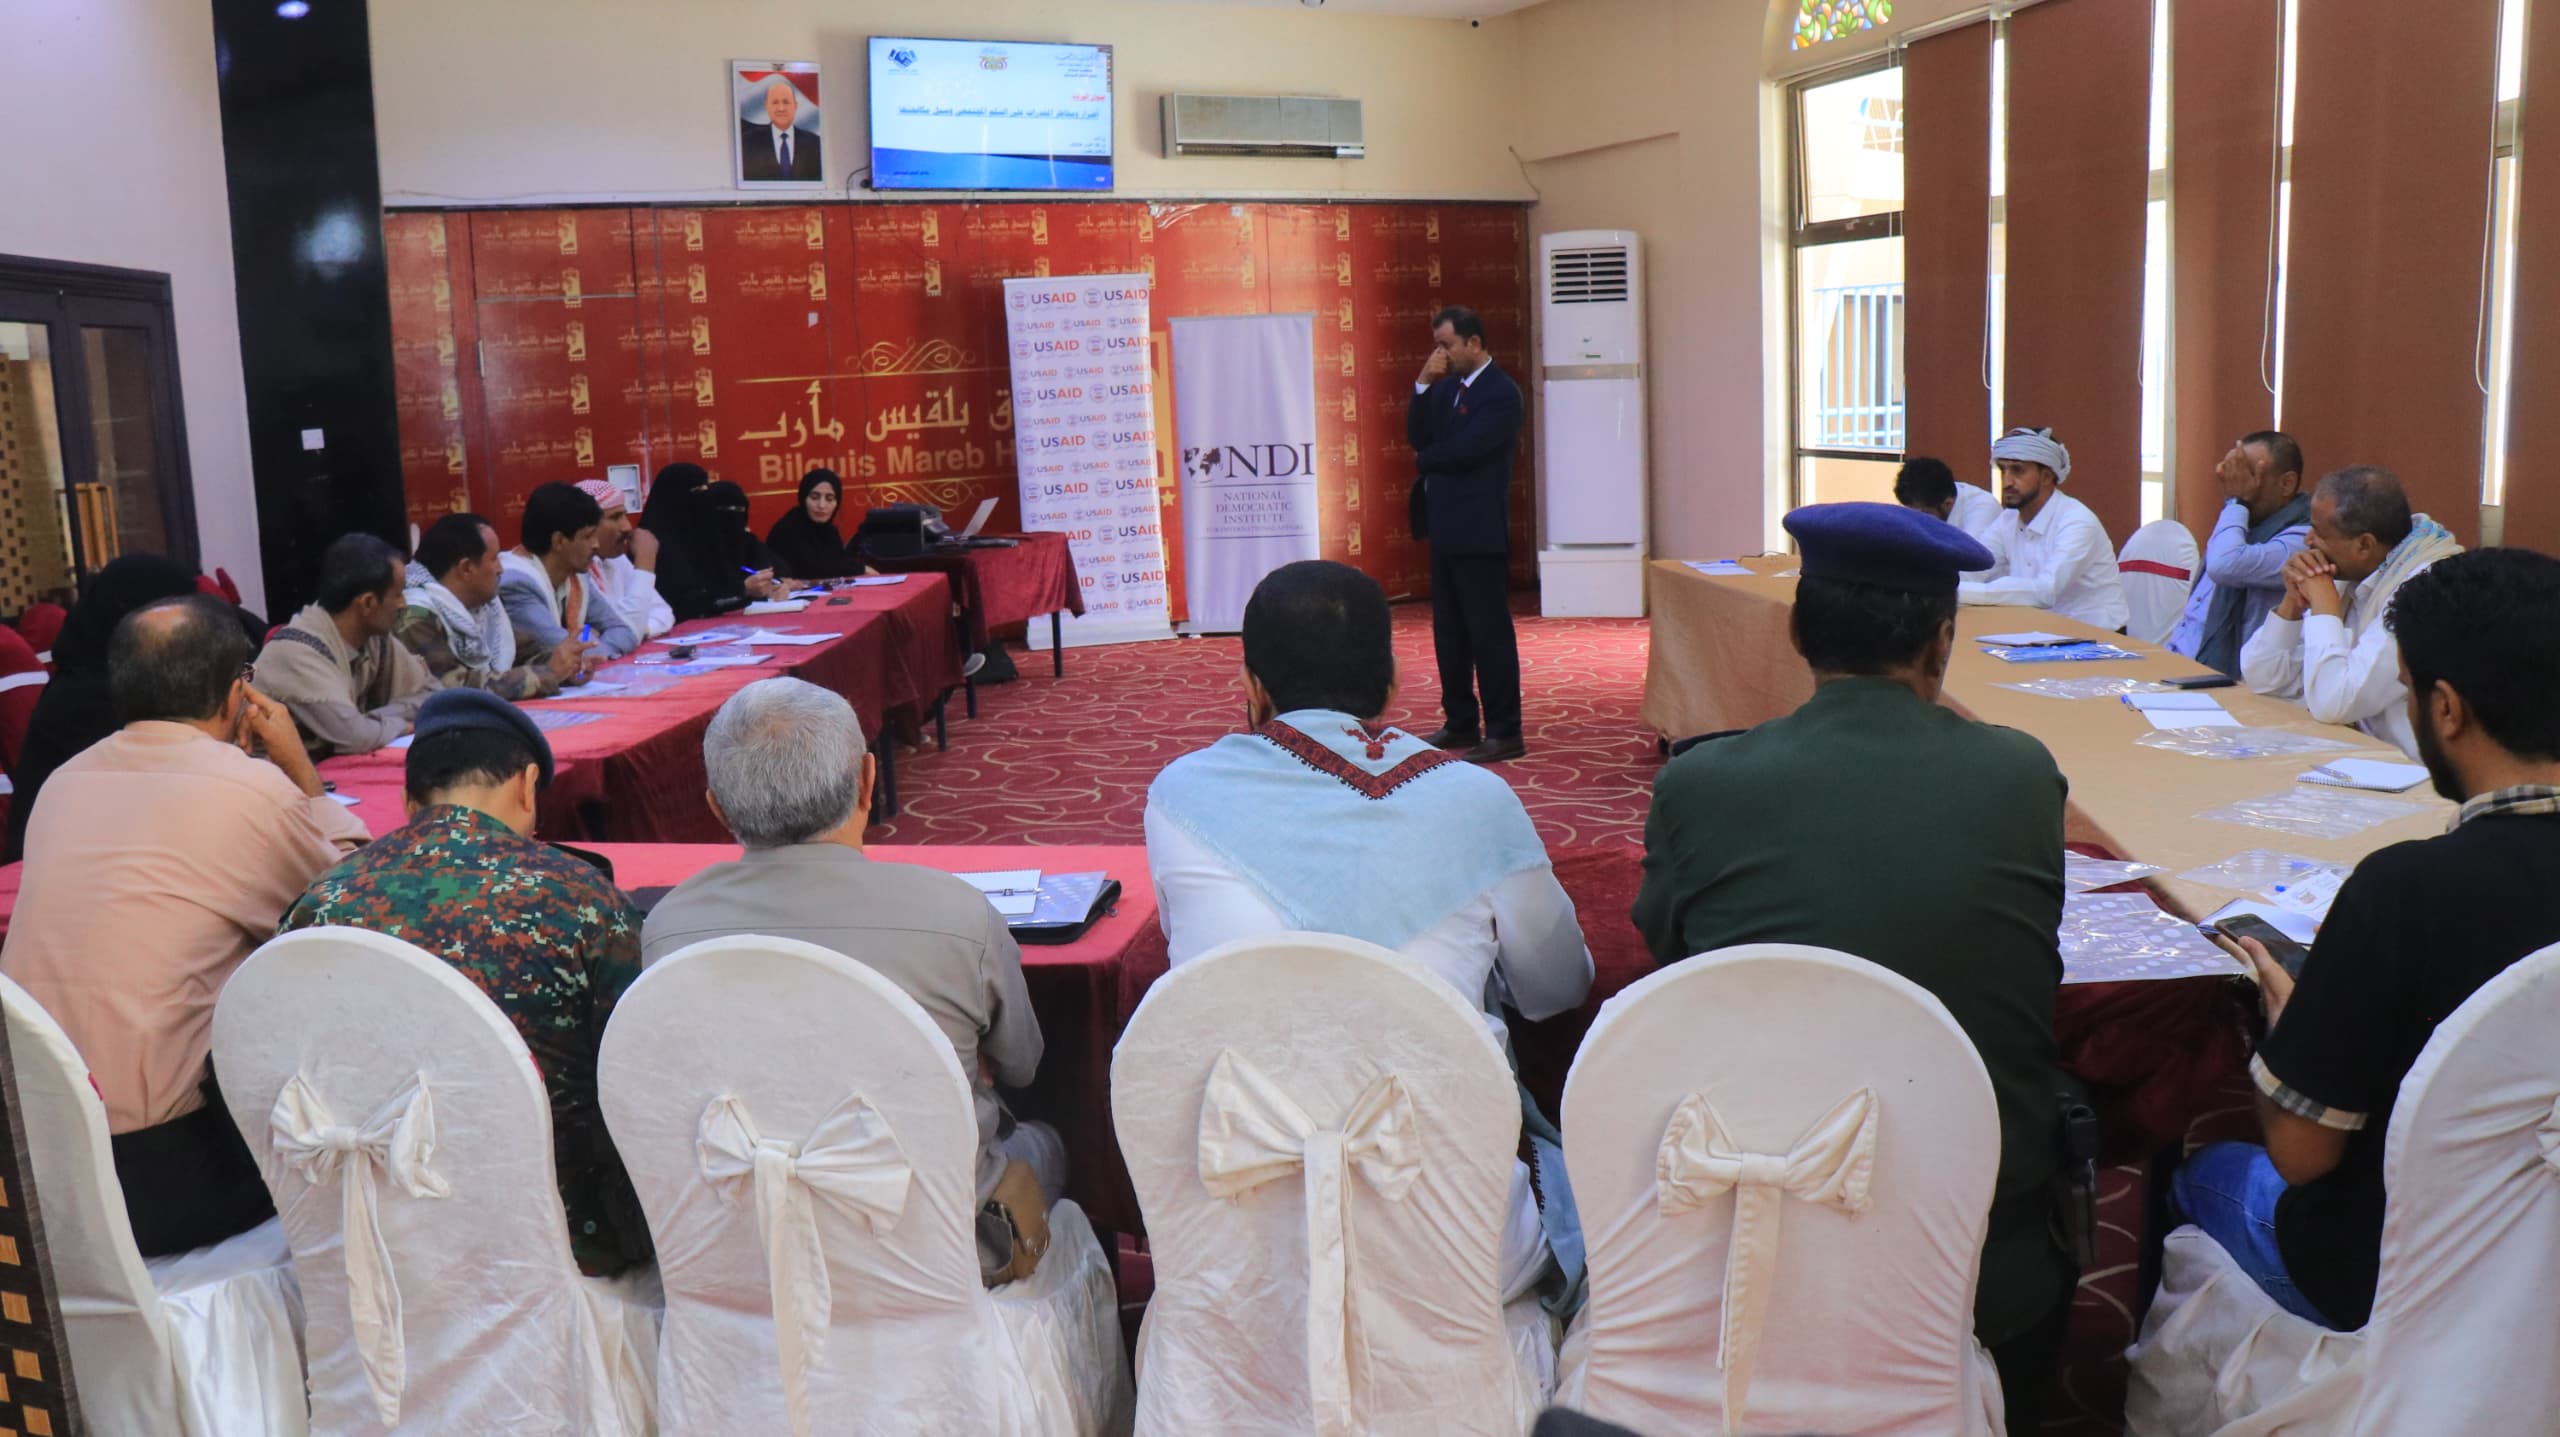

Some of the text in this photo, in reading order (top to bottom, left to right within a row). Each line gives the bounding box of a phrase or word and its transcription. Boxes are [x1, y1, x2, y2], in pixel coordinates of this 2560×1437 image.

[1031, 292, 1076, 304] USAID
[1105, 289, 1148, 301] USAID
[1074, 320, 1101, 328] USAID
[1035, 340, 1079, 352] USAID
[1108, 336, 1149, 348] USAID
[1077, 367, 1103, 375] USAID
[1038, 388, 1082, 400] USAID
[1110, 384, 1151, 396] USAID
[738, 379, 846, 448] مأرب
[866, 385, 969, 442] بلقيس
[1041, 435, 1086, 448] USAID
[1113, 432, 1155, 443] USAID
[886, 442, 985, 475] Mareb
[1224, 443, 1315, 478] NDI
[1037, 465, 1063, 473] USAID
[1083, 461, 1109, 470] USAID
[1044, 483, 1088, 495] USAID
[1116, 479, 1157, 490] USAID
[1223, 490, 1284, 501] NATIONAL
[1086, 508, 1112, 517] USAID
[1215, 502, 1293, 513] DEMOCRATIC
[1040, 512, 1067, 520] USAID
[1223, 513, 1285, 524] INSTITUTE
[1068, 530, 1091, 541] AID
[1119, 525, 1160, 537] USAID
[1134, 552, 1160, 560] USAID
[1122, 571, 1163, 583] USAID
[1092, 602, 1119, 611] USAID
[1137, 598, 1162, 606] USAID
